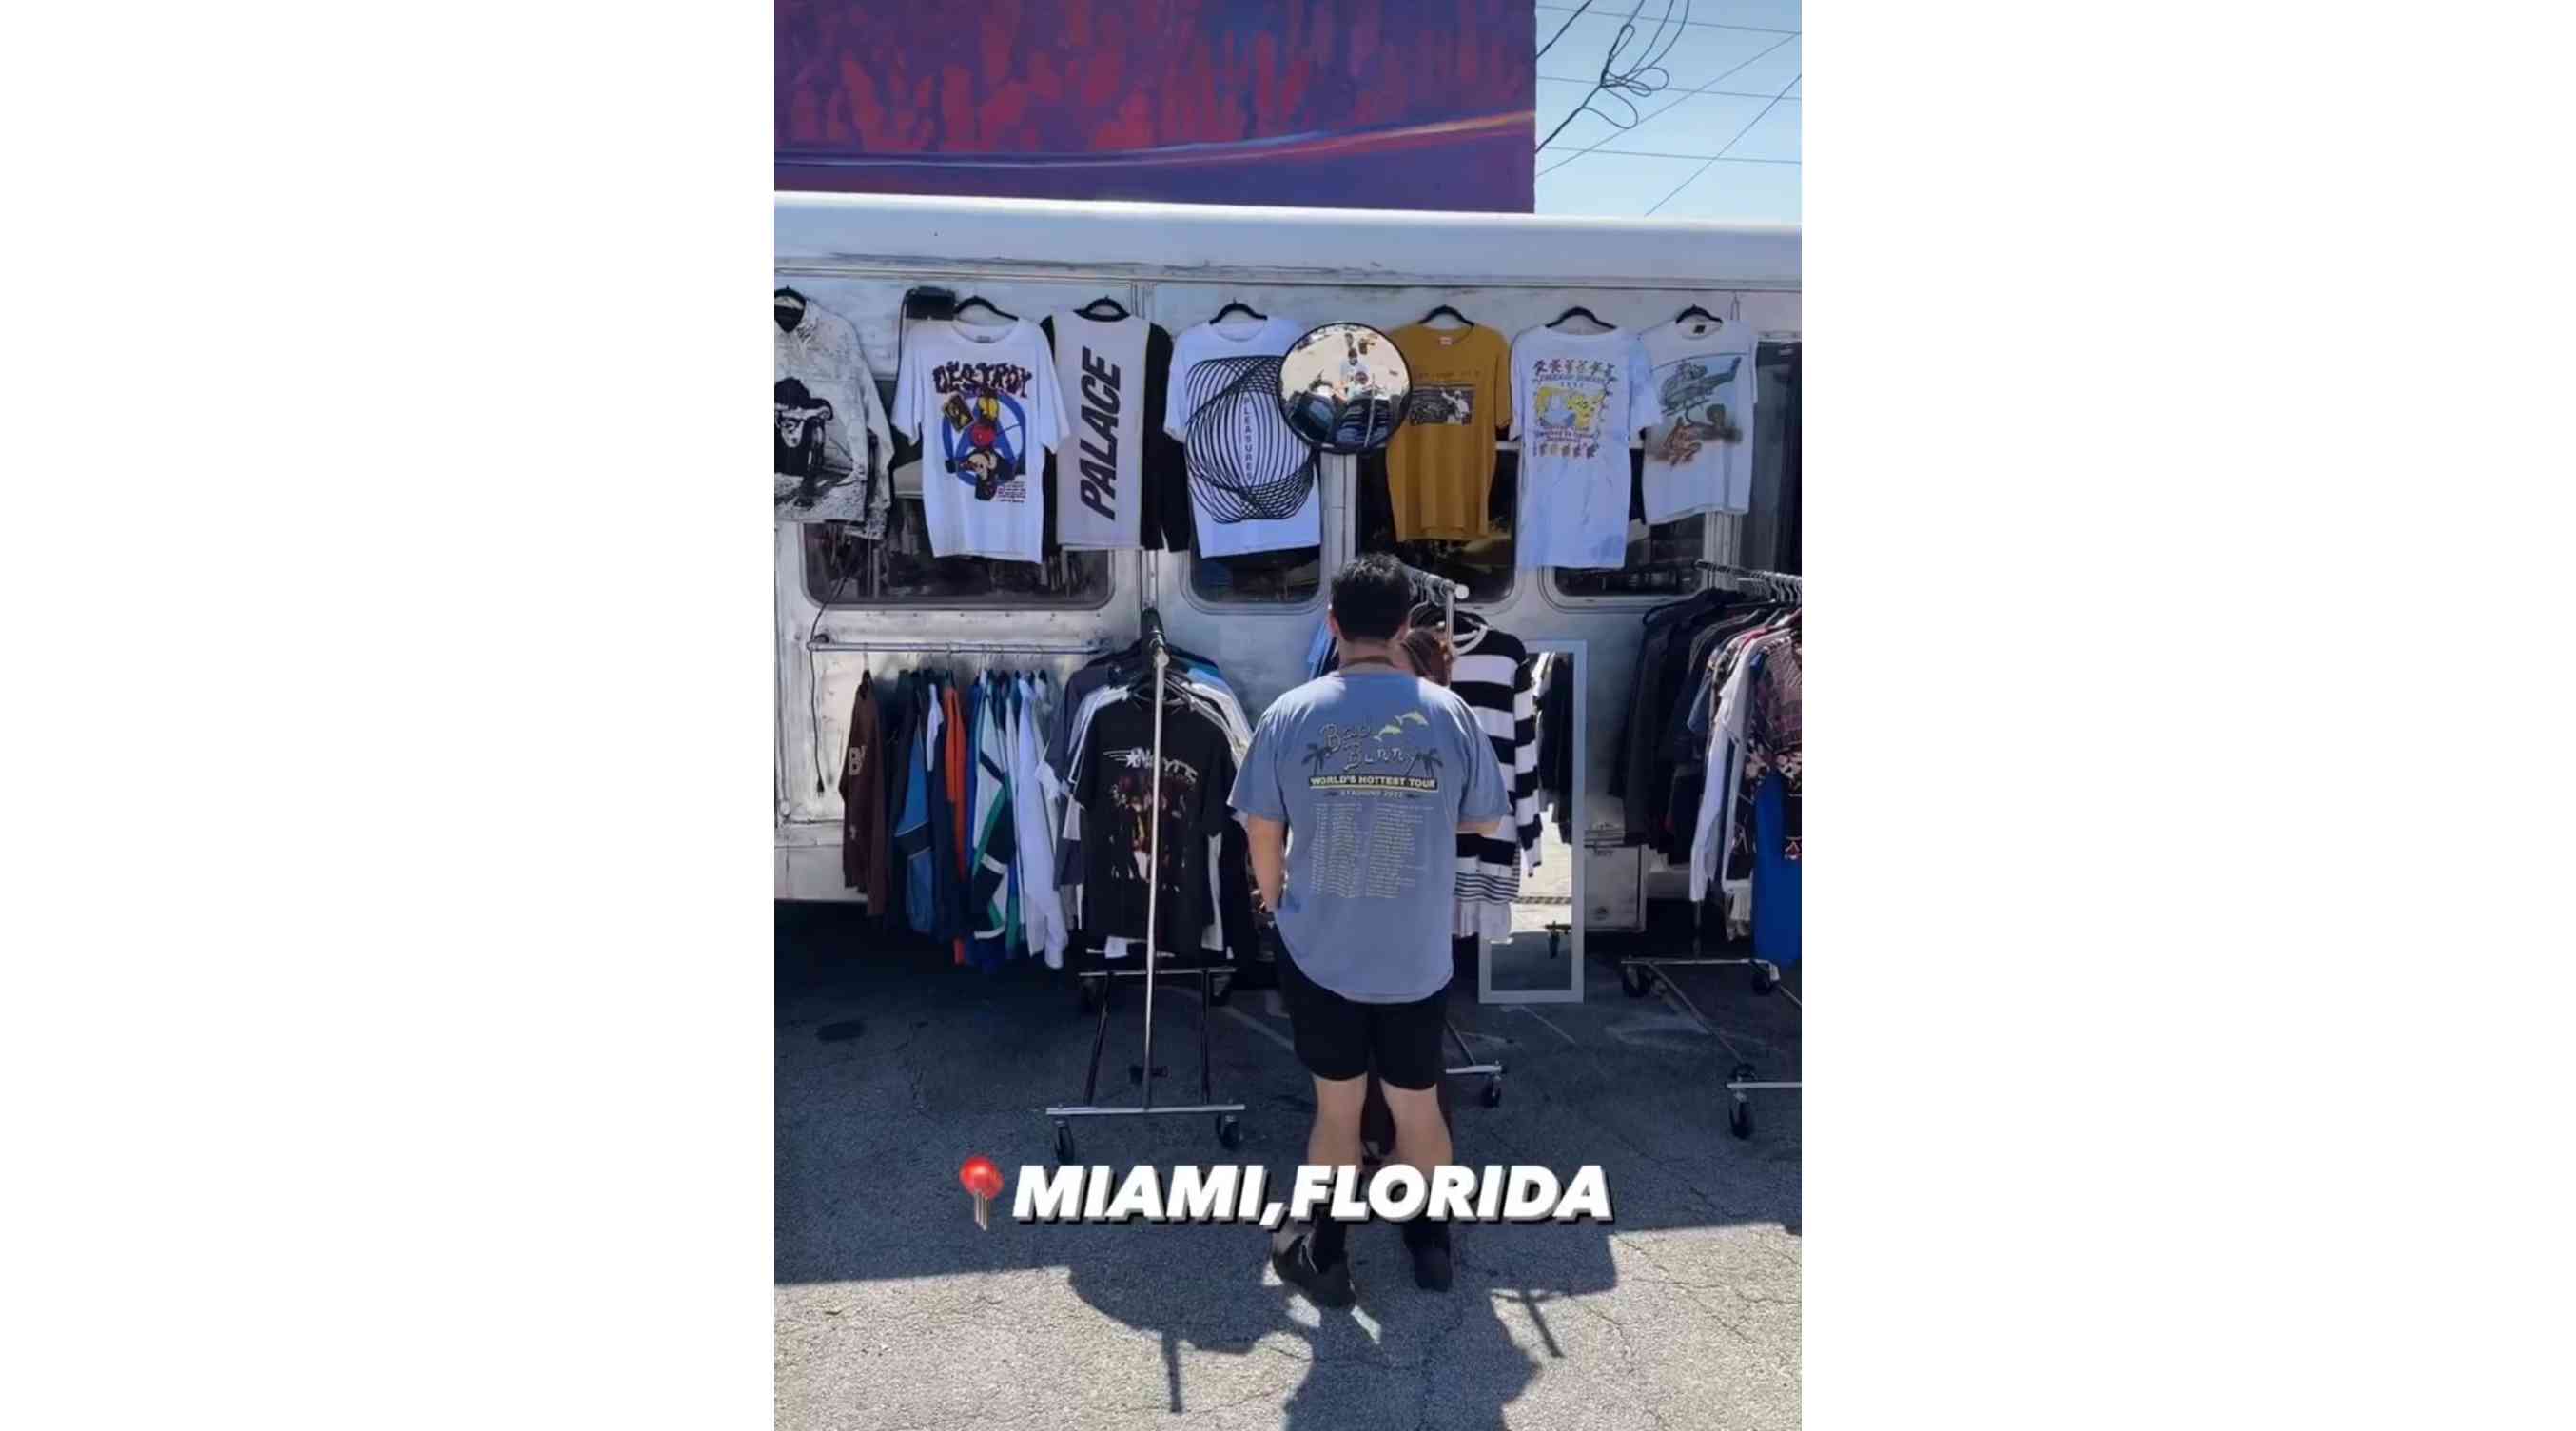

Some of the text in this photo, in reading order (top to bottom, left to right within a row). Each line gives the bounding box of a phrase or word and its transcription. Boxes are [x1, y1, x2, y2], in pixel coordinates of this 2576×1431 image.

[932, 361, 1032, 398] DESTROY
[1079, 346, 1121, 521] PALACE
[1310, 775, 1436, 789] WORLD'S HOTTEST TOUR
